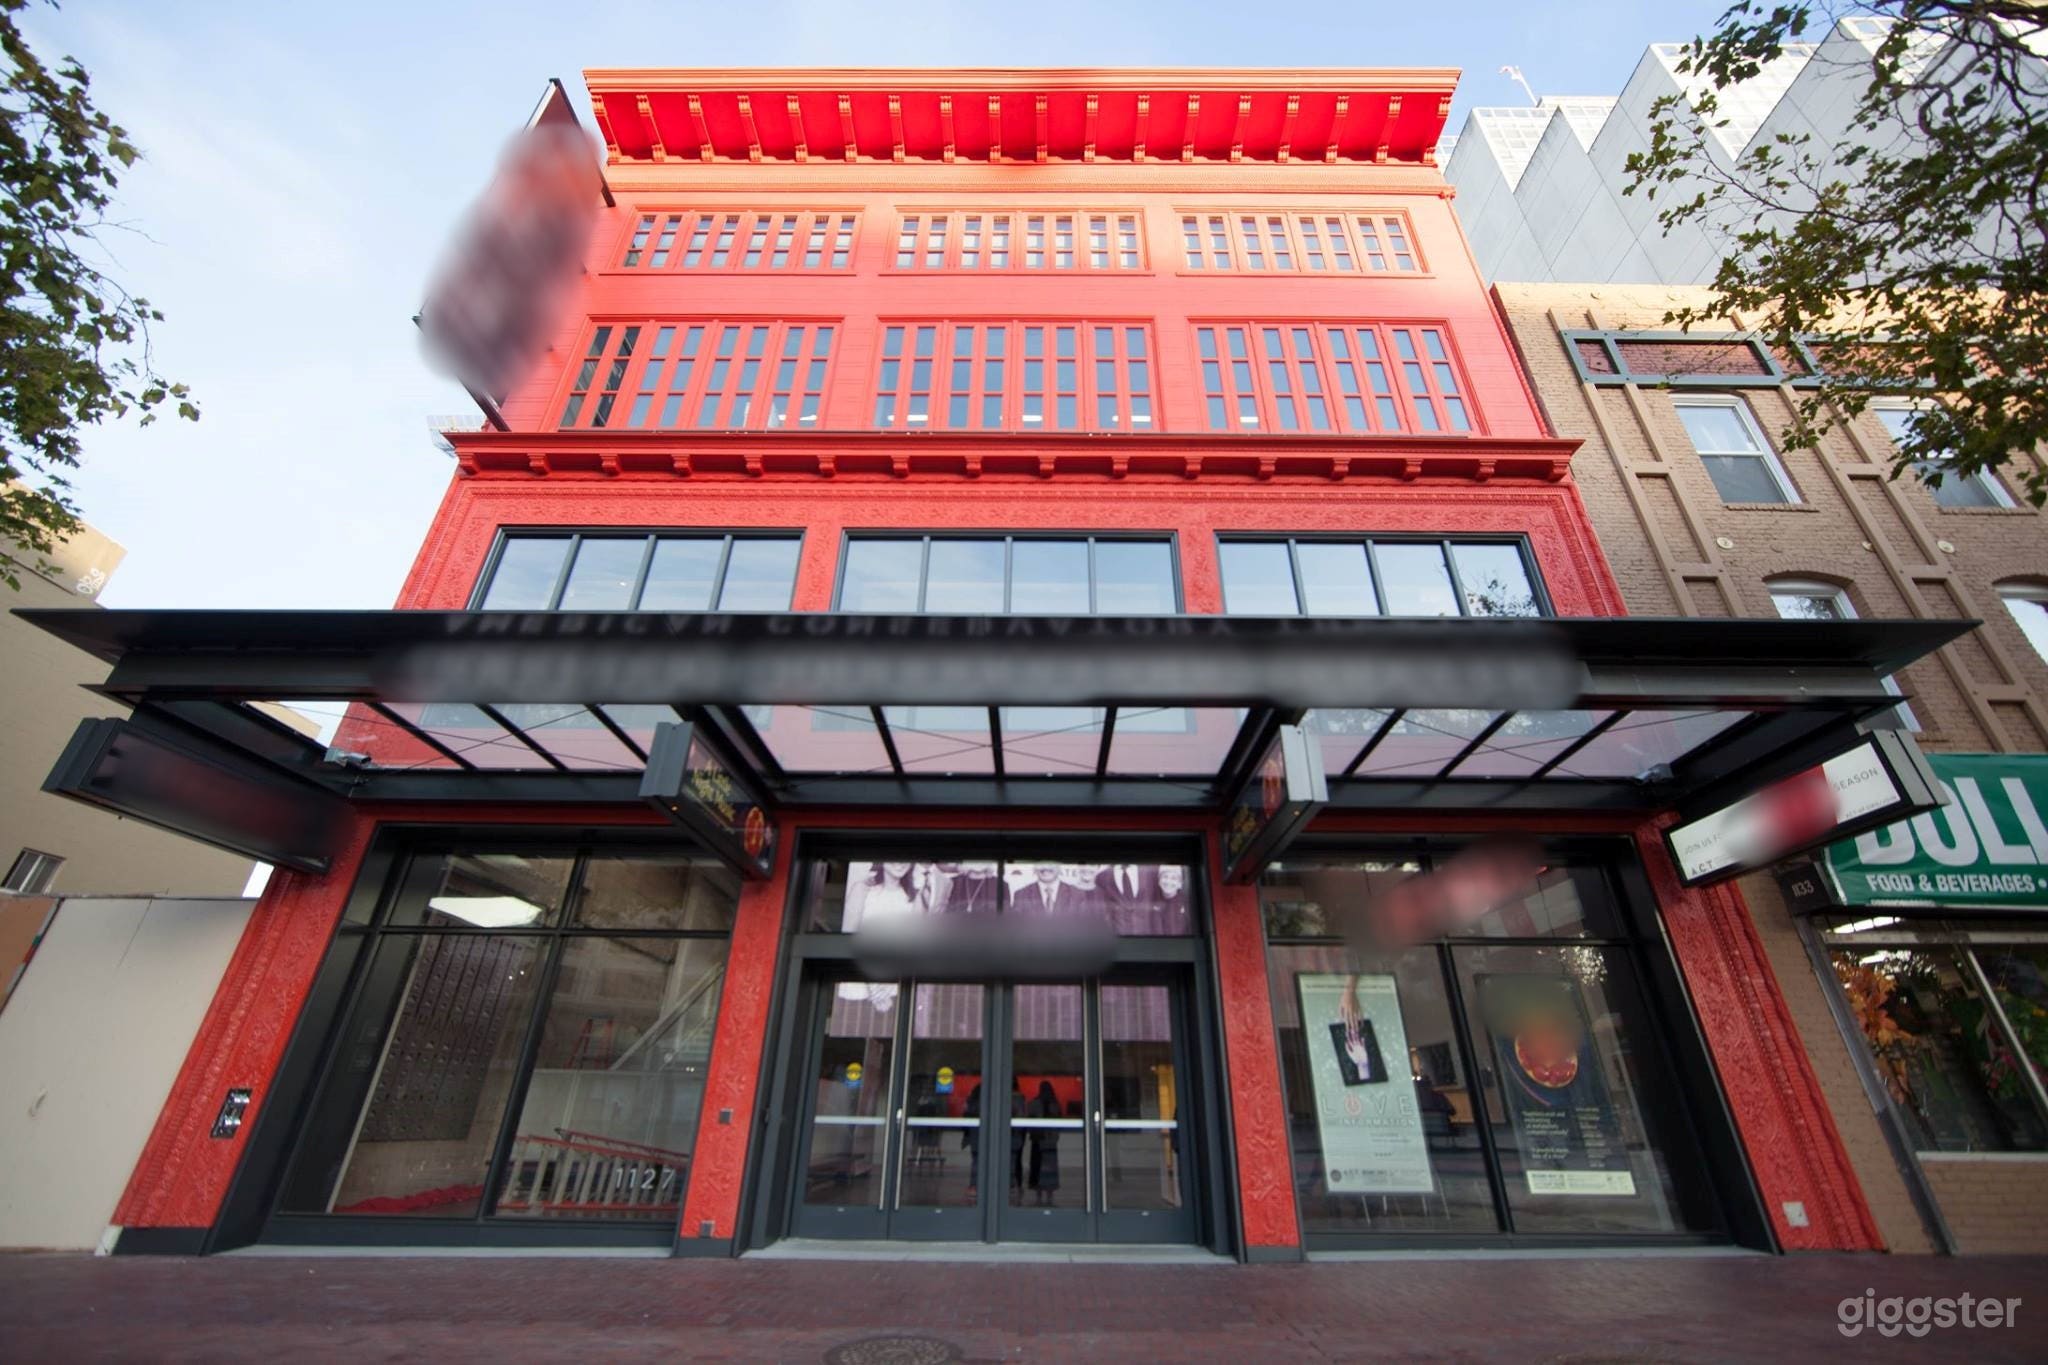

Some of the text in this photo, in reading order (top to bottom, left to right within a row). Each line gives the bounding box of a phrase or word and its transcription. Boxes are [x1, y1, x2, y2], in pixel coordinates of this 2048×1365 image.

[1833, 768, 1878, 791] SEASON
[1866, 873, 2036, 893] FOOD & BEVERAGES
[1321, 1094, 1415, 1117] LOVE
[615, 1167, 676, 1190] 1127
